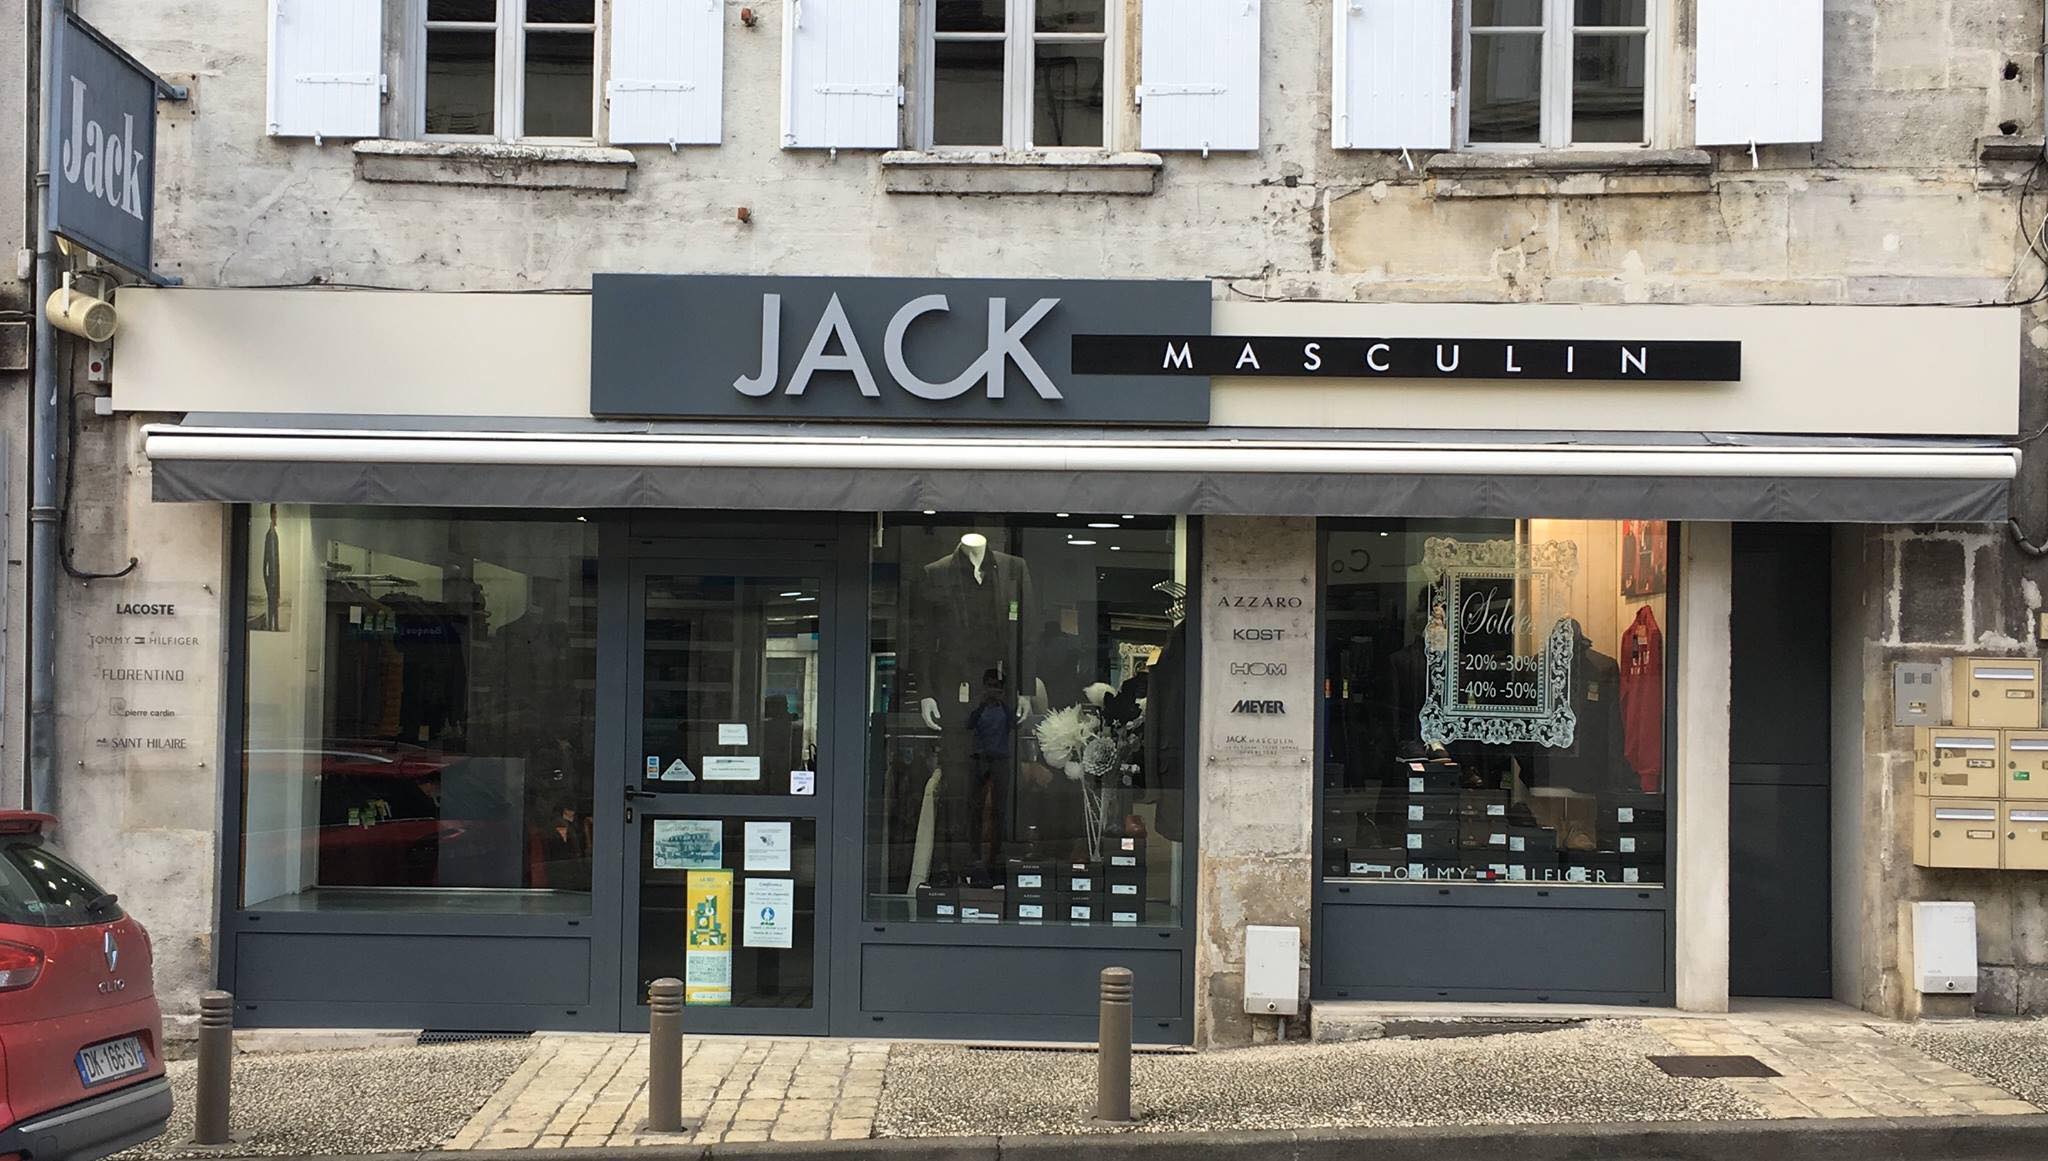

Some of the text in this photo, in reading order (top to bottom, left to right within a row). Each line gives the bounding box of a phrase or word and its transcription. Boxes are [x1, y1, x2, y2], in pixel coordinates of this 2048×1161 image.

[63, 74, 144, 222] Jack
[732, 291, 1064, 400] JACK
[1162, 342, 1648, 374] MASCULIN
[116, 603, 175, 616] LACOSTE
[1217, 596, 1302, 609] AZZARO
[88, 635, 199, 648] TOMMY HILFIGER
[1233, 628, 1285, 641] KOST
[1230, 662, 1287, 676] HOM
[1460, 653, 1538, 672] -20% -30%
[102, 668, 185, 682] FLORENTINO
[1460, 680, 1537, 699] -40% -50%
[124, 709, 175, 718] pierre cardin
[1230, 700, 1286, 714] MEYER
[111, 737, 187, 750] SAINT HILAIRE
[1226, 735, 1247, 744] JACK
[98, 978, 125, 993] CLIO
